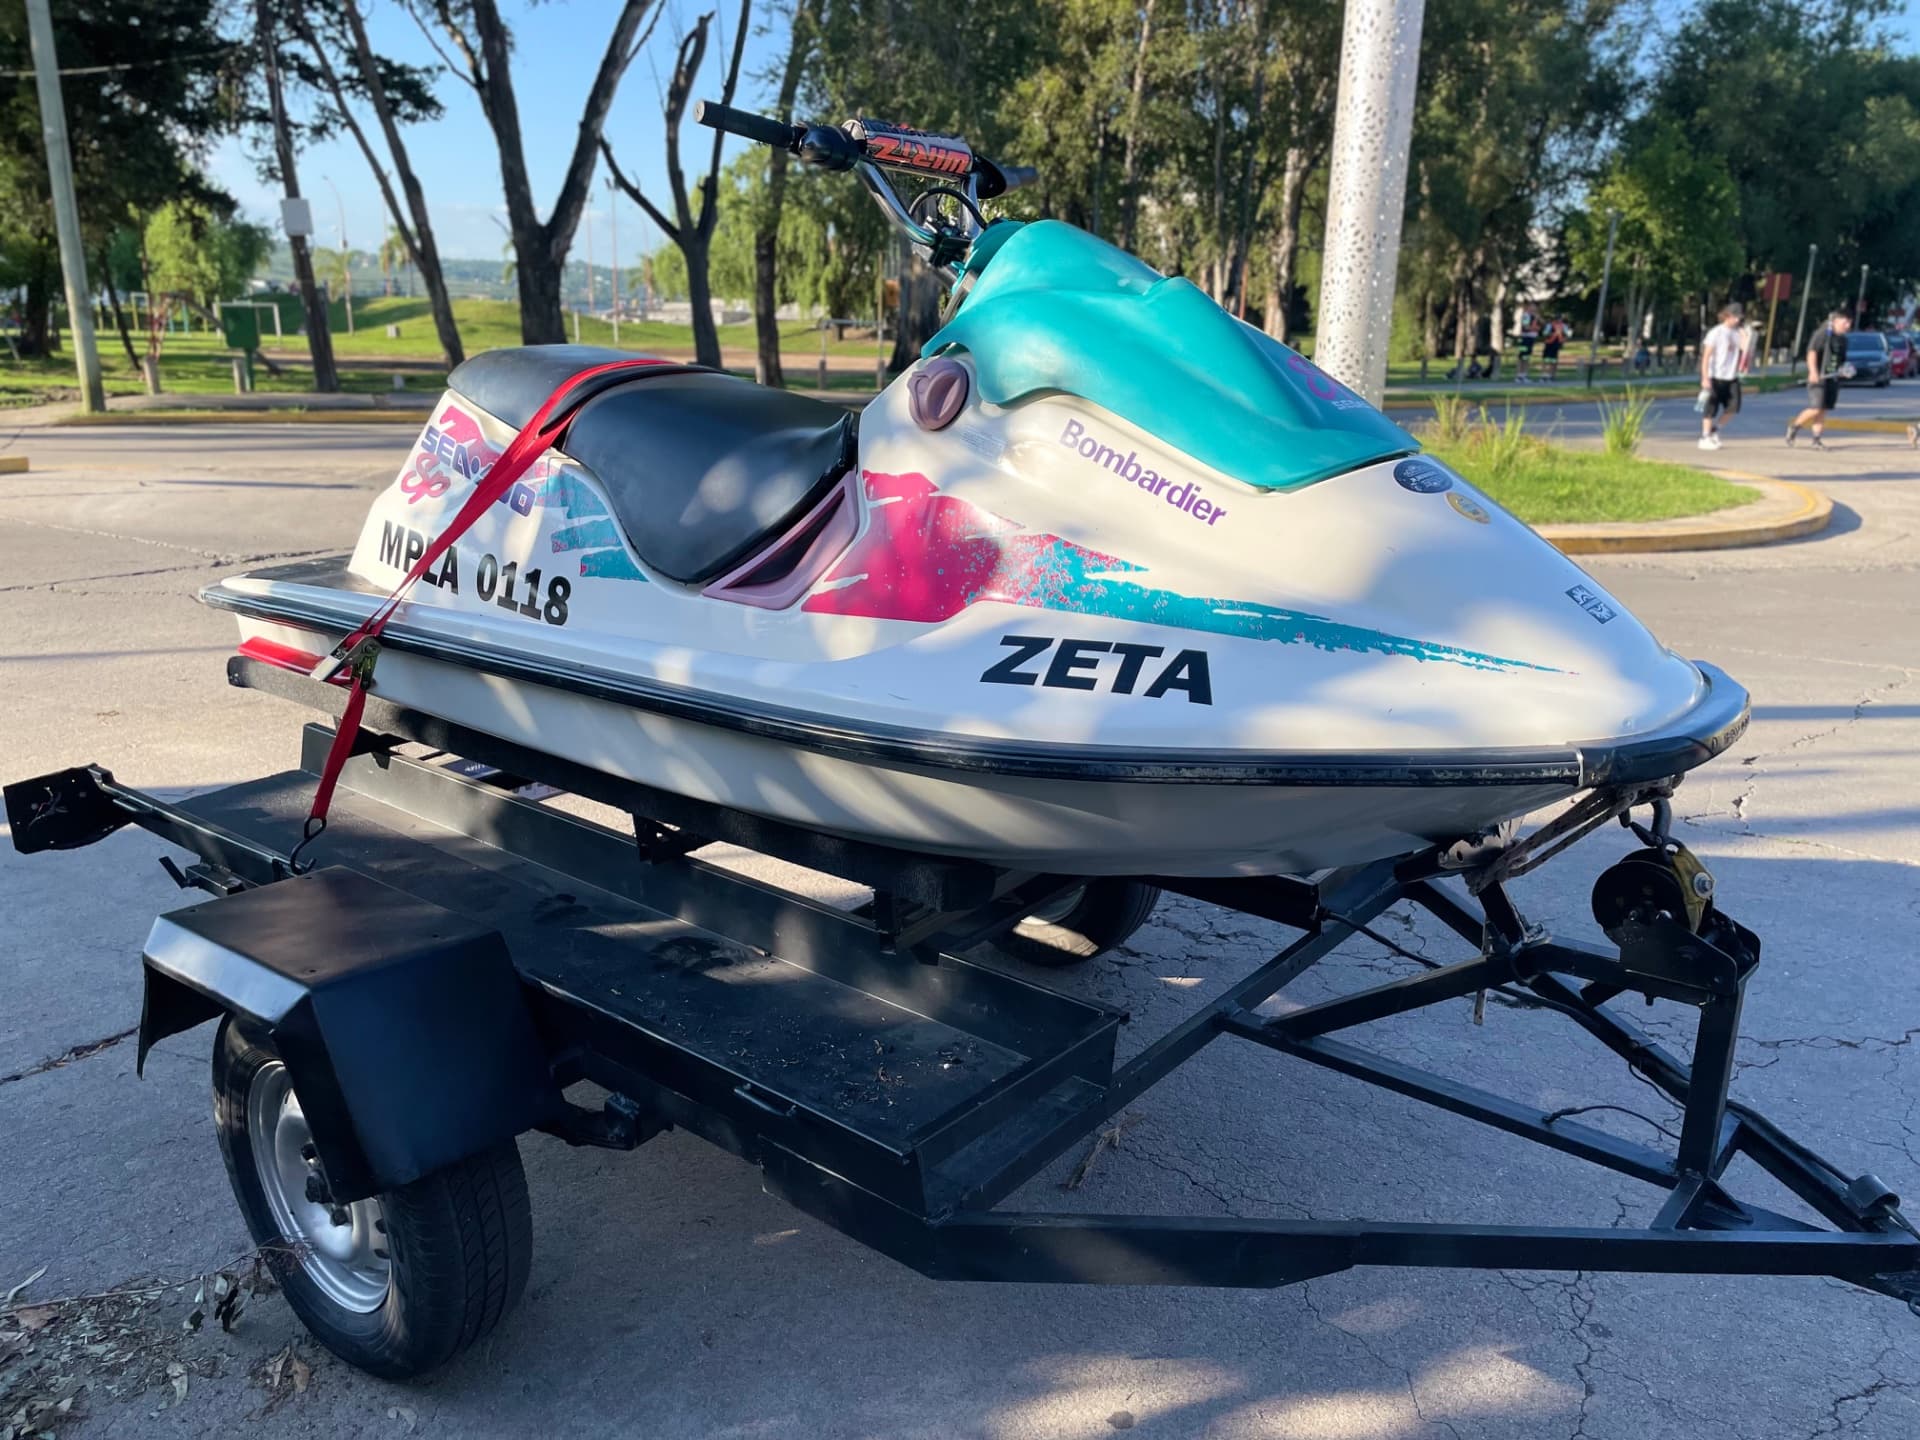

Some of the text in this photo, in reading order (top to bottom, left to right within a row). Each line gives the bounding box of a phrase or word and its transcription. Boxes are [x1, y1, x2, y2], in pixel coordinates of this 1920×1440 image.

[1059, 418, 1228, 526] Bombardier
[476, 553, 572, 626] 0118
[979, 635, 1213, 706] ZETA
